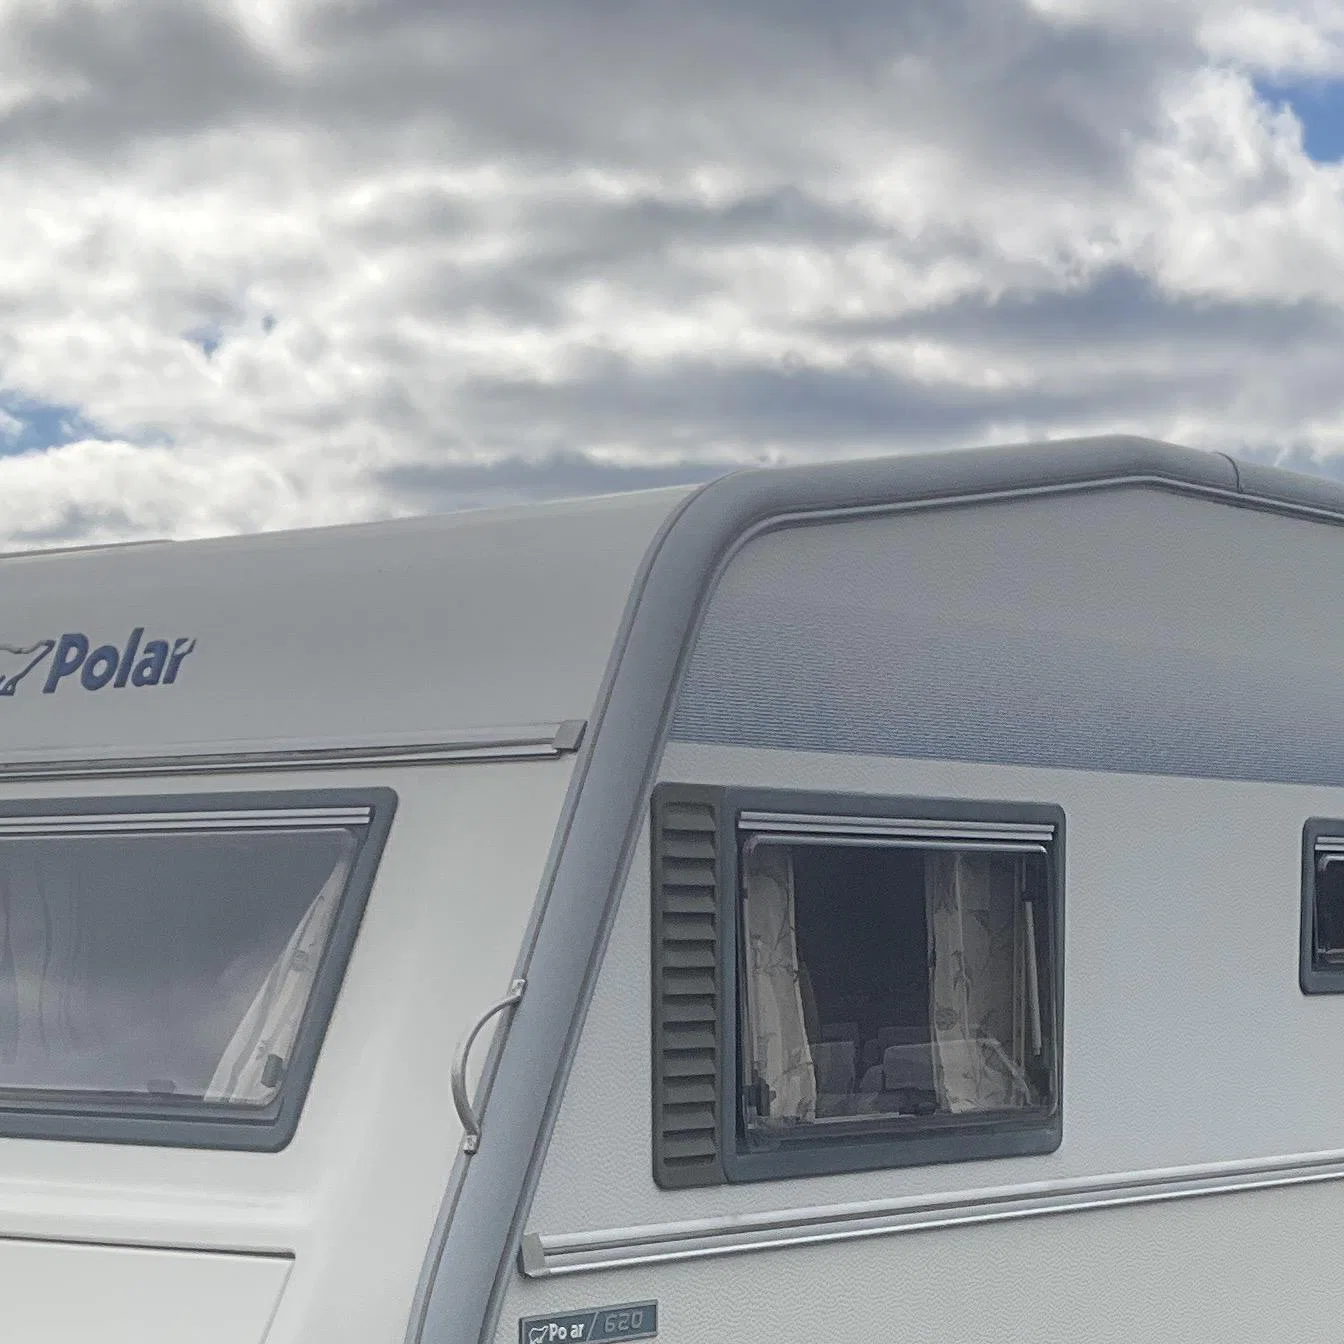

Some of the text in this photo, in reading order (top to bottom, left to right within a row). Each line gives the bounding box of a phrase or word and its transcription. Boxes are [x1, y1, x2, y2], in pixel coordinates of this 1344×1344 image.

[43, 627, 197, 694] Polar
[549, 1311, 644, 1342] Poar 620
